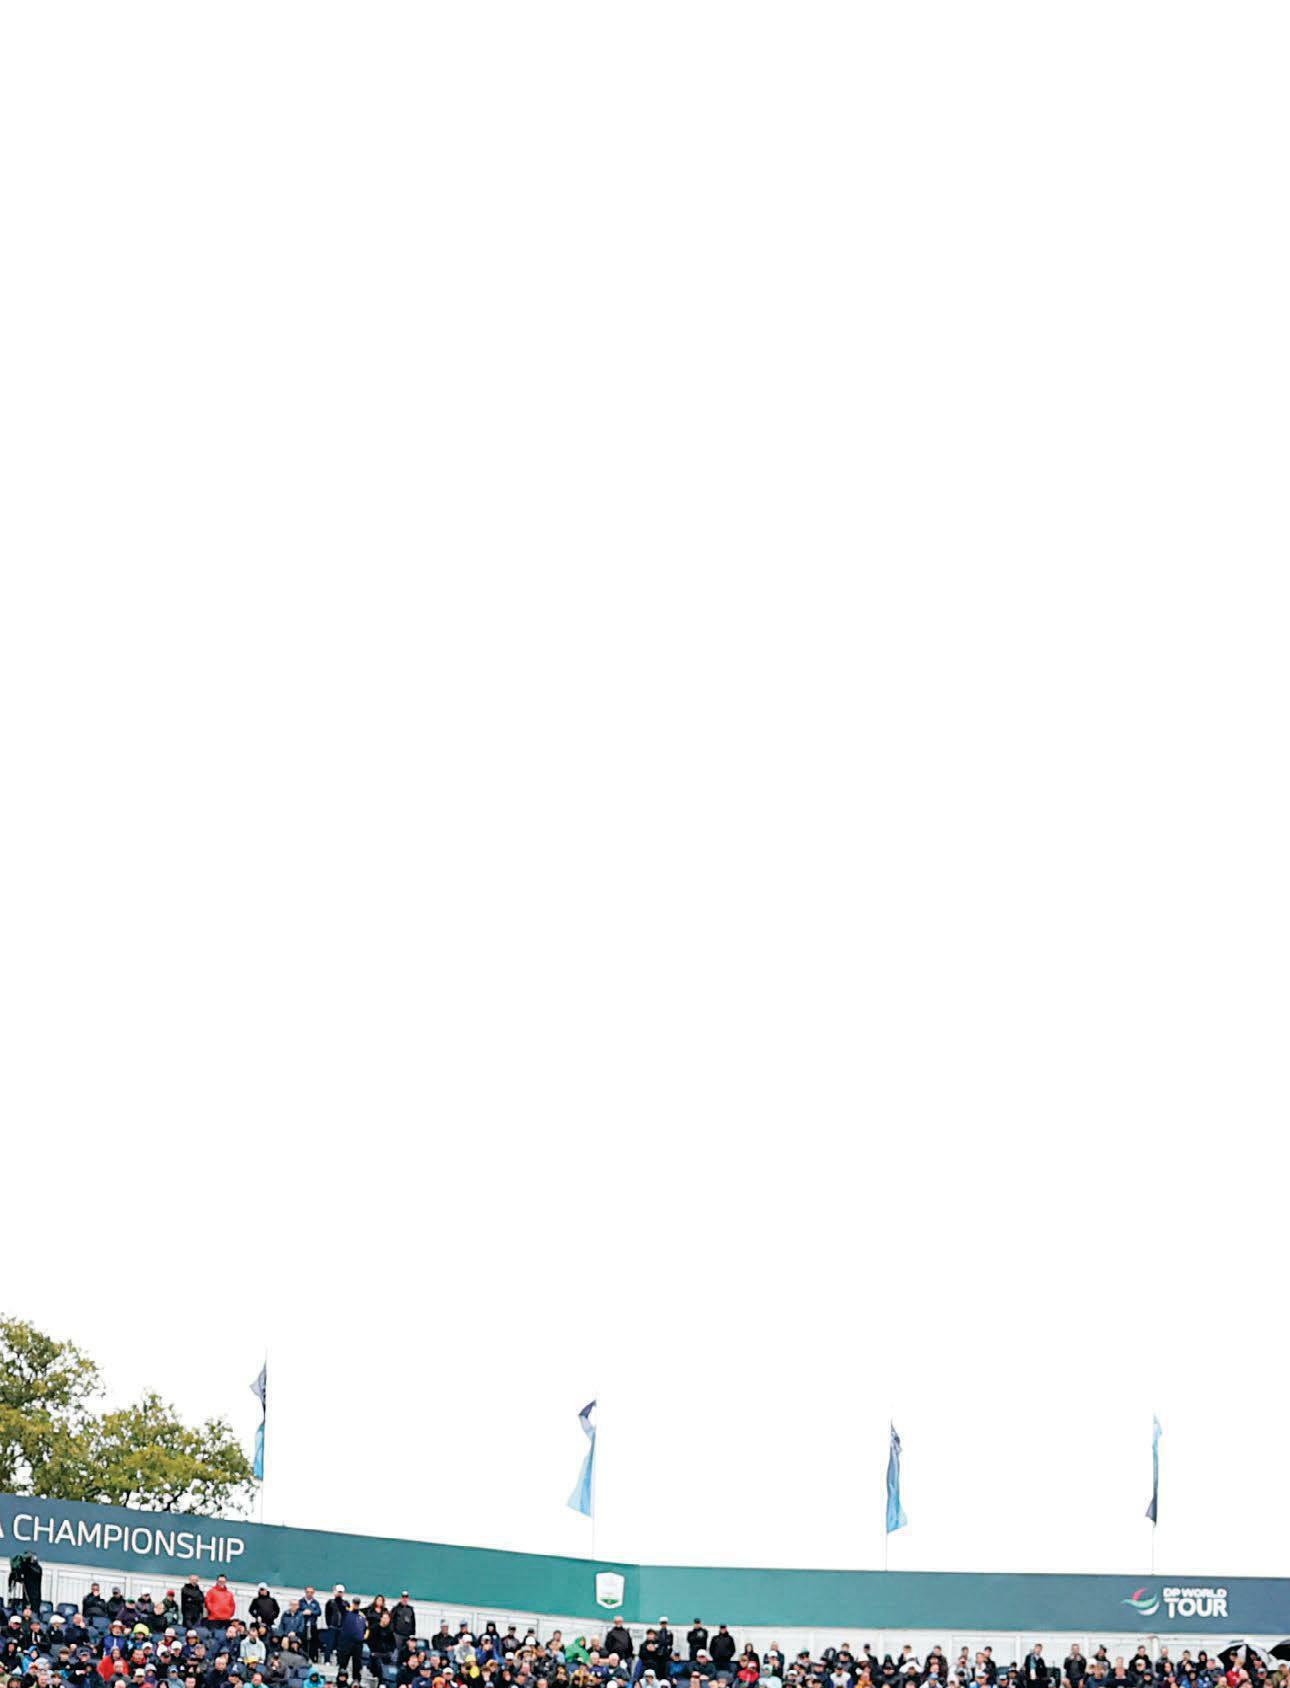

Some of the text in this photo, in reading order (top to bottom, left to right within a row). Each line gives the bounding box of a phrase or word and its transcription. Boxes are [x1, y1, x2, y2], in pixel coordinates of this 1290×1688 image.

[13, 1513, 245, 1563] CHAMPIONSHIP
[1163, 1587, 1227, 1599] DP WORLD
[1163, 1598, 1228, 1618] TOUR
